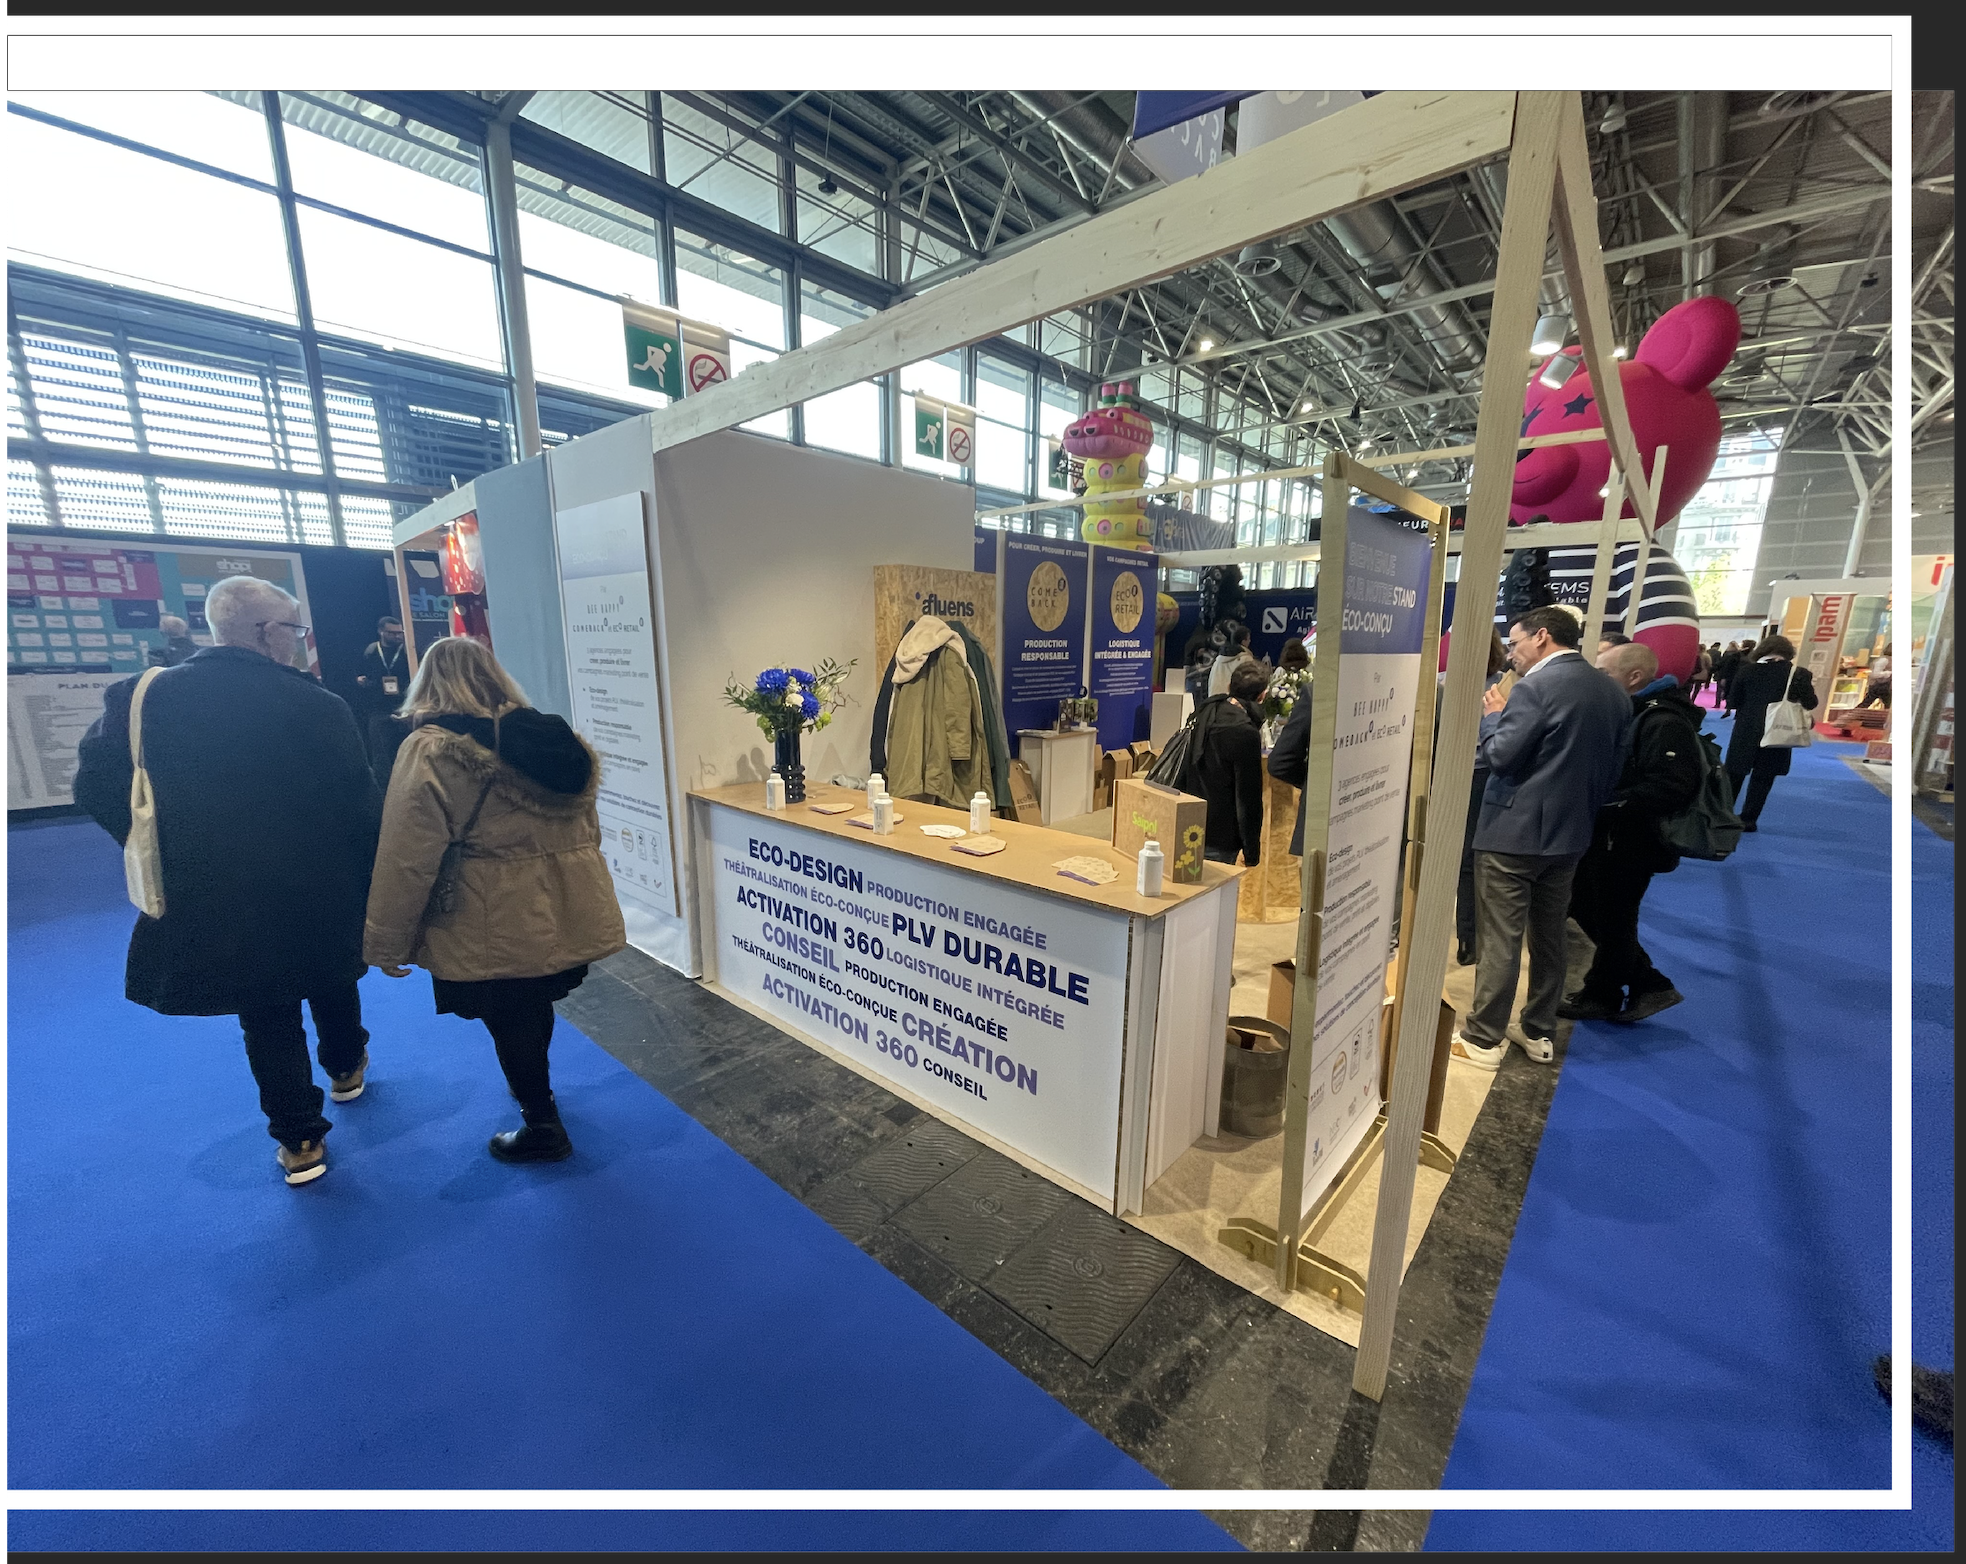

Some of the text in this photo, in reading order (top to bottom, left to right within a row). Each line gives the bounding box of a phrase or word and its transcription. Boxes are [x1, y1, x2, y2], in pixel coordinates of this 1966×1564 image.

[1009, 541, 1022, 550] POUR
[410, 587, 455, 612] sho
[1031, 587, 1057, 597] COME
[1116, 589, 1130, 601] ECO
[1393, 586, 1416, 608] STAND
[1031, 599, 1056, 608] BACK
[1115, 604, 1140, 615] RETAIL
[1290, 607, 1317, 620] AiR
[1342, 603, 1393, 638] ÉCO-CONÇU
[1809, 597, 1842, 643] ipam
[572, 624, 604, 632] COMEBACK
[623, 624, 639, 632] RETAIL
[1024, 640, 1068, 648] PRODUCTION
[1109, 640, 1140, 648] LOGISTIQUE
[1021, 651, 1069, 661] RESPONSABLE
[1095, 649, 1122, 659] INTÉGRÉE
[1127, 649, 1152, 658] ENGAGÉE
[1333, 730, 1368, 750] OMEBACK
[749, 838, 1047, 950] ECO-DESIGN PRODUCTION ENGAGÉE
[724, 858, 1089, 1005] THÉÂTRALISATION ÉCO-CONÇUE PLV DURABLE
[737, 885, 1064, 1030] ACTIVATION 360 LOGISTIQUE INTÉGRÉE
[762, 921, 1008, 1042] CONSEIL PRODUCTION ENGAGÉE
[732, 935, 1037, 1096] THÉÂTRALISATION ÉCO-CONÇUE CRÉATION
[762, 973, 988, 1101] ACTIVATION 360 CONSEIL
